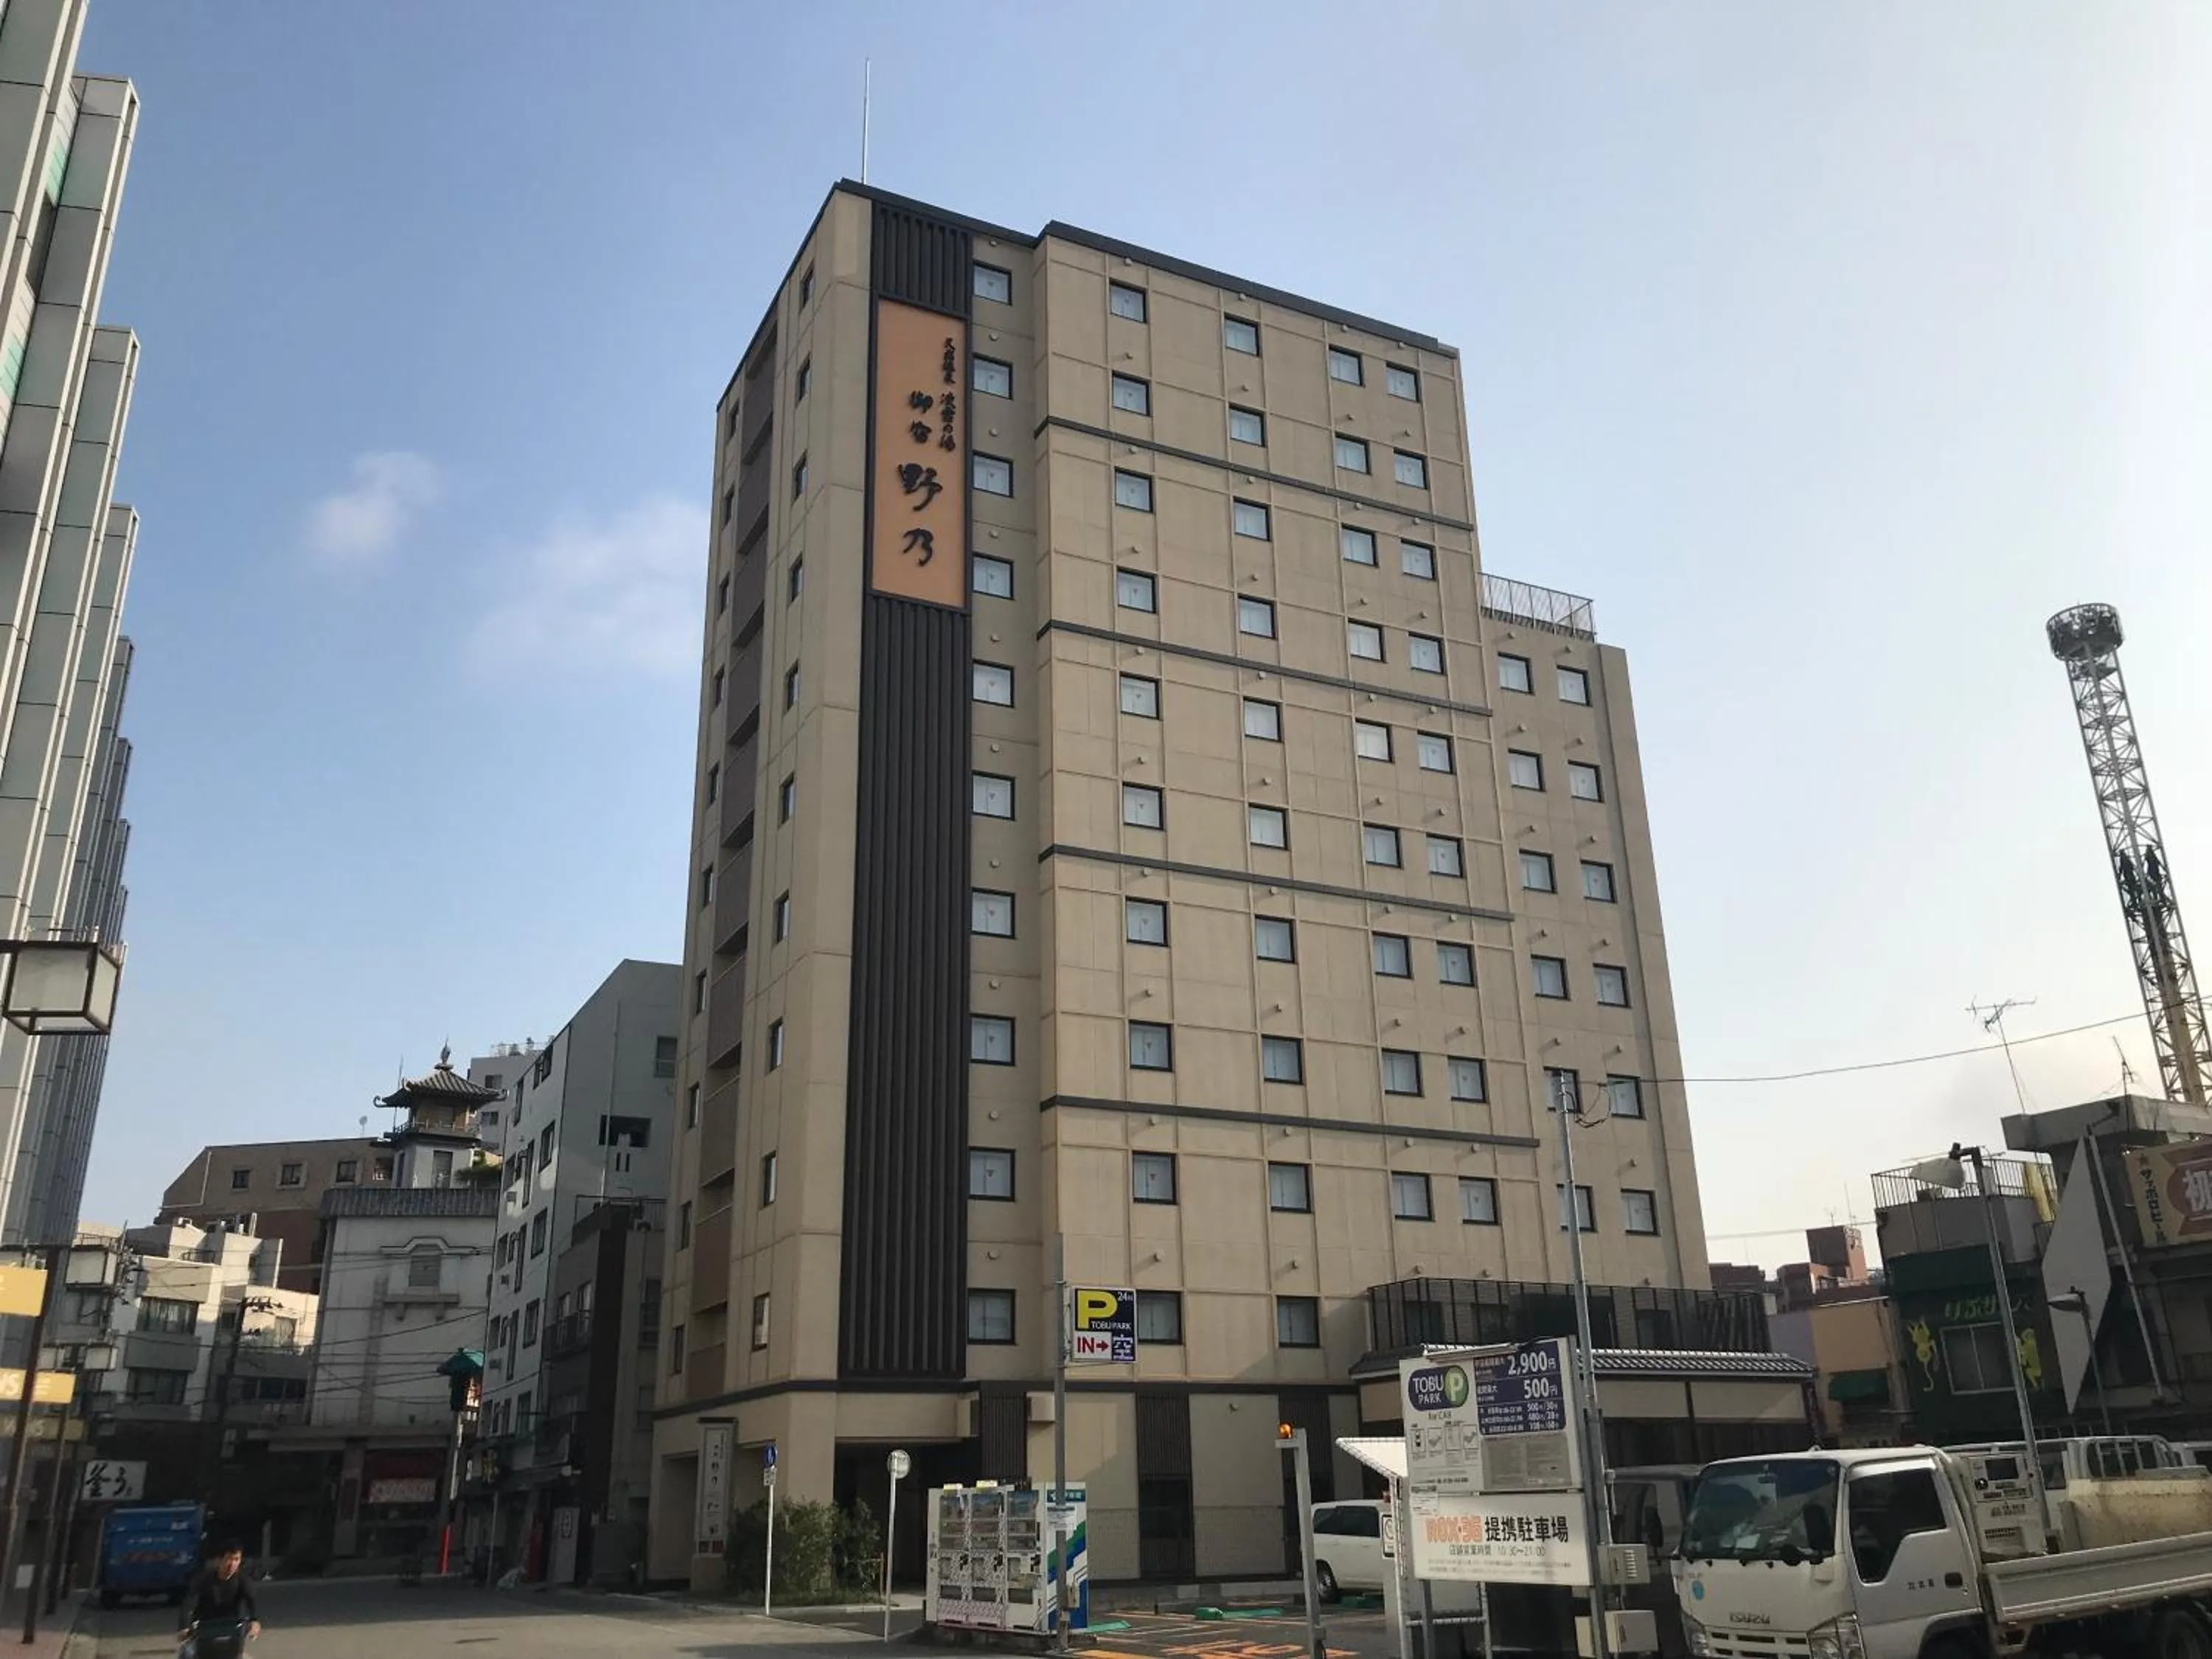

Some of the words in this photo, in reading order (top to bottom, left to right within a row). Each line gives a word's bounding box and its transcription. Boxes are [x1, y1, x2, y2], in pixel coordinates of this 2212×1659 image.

[1077, 1290, 1118, 1329] P
[1112, 1321, 1132, 1330] PARK
[1077, 1337, 1095, 1354] IN
[1508, 1351, 1556, 1376] 2,900円
[1412, 1374, 1444, 1394] TOBU
[1450, 1373, 1464, 1401] P
[1523, 1377, 1558, 1399] 500円
[1418, 1393, 1442, 1405] PARK
[1484, 1515, 1569, 1543] 提携駐車場
[1729, 1611, 1770, 1624] ISUZU
